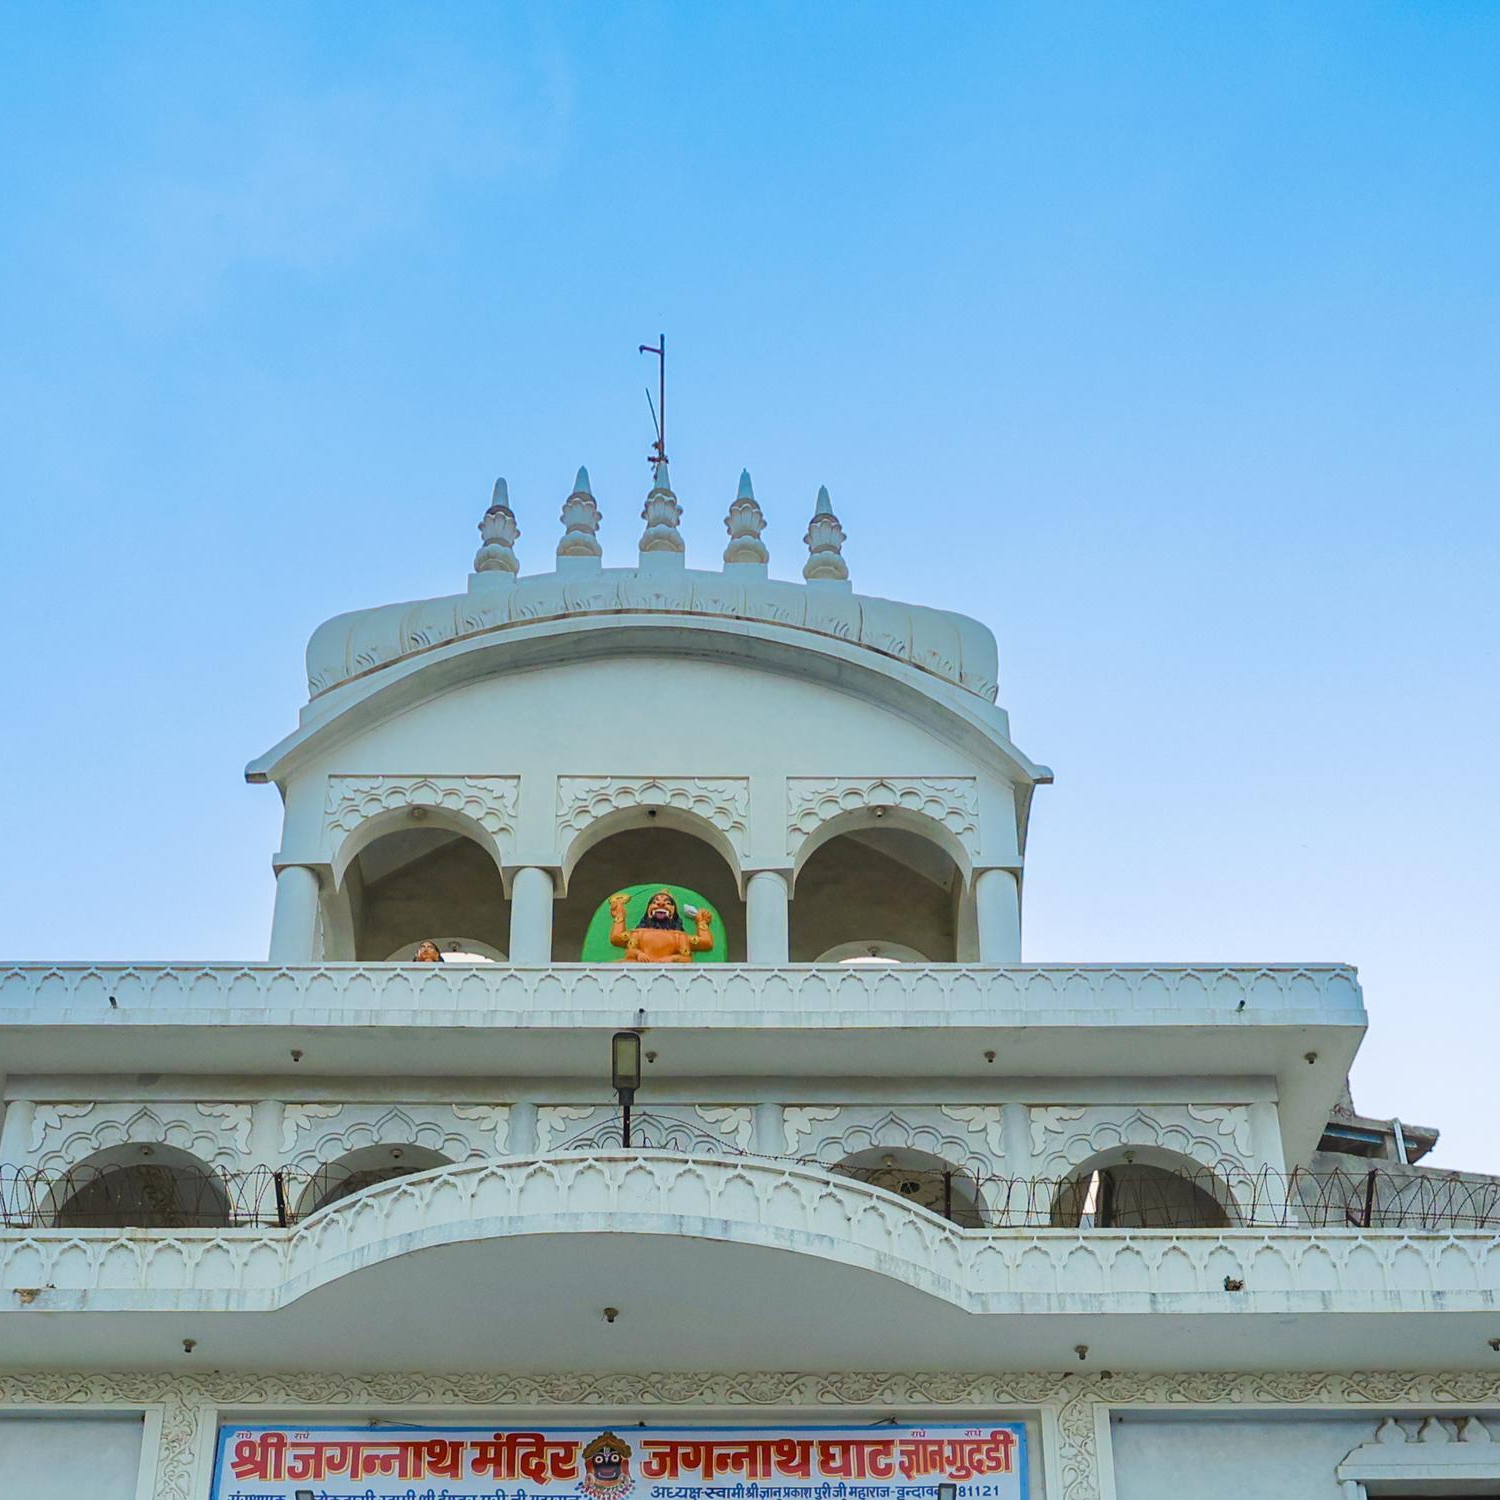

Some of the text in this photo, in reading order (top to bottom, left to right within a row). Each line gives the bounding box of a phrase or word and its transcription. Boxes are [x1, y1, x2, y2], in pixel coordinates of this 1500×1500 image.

[230, 1432, 582, 1485] श्री जगन्नाथ मंदिर
[640, 1439, 815, 1480] जगन्नाथ
[816, 1439, 896, 1480] घाट
[746, 1481, 759, 1499] श्री
[759, 1486, 781, 1500] ज्ञान
[782, 1486, 813, 1499] प्रकाश
[814, 1482, 833, 1500] पुरी
[832, 1482, 848, 1498] जी
